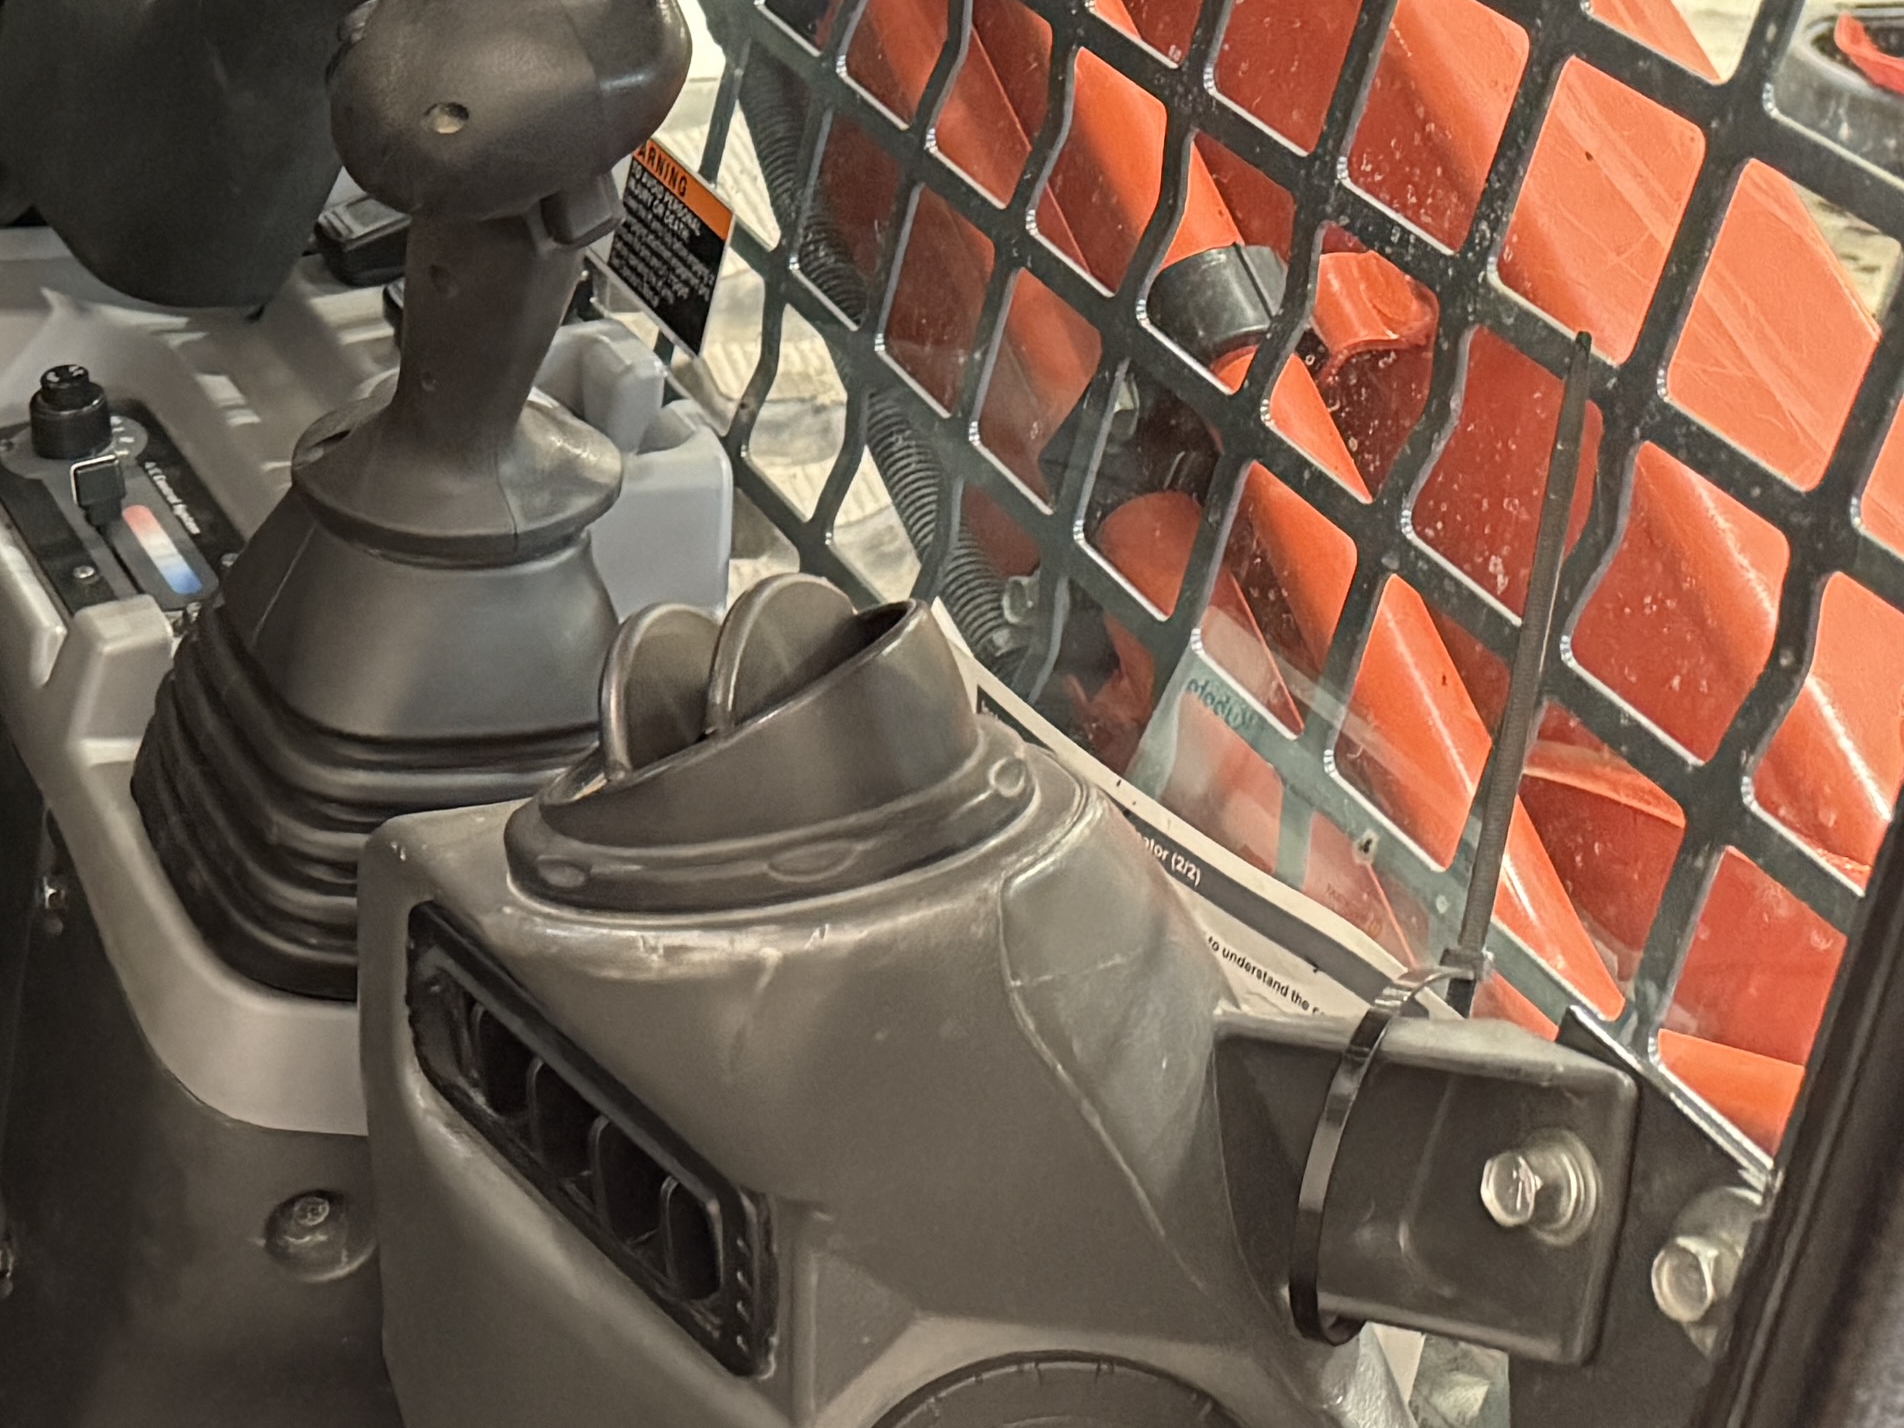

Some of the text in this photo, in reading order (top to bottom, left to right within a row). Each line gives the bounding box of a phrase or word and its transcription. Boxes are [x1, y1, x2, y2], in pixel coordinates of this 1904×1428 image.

[638, 144, 688, 198] ARNING
[1171, 851, 1202, 888] (2/2)
[1222, 947, 1290, 997] understand
[1291, 988, 1310, 1011] the
